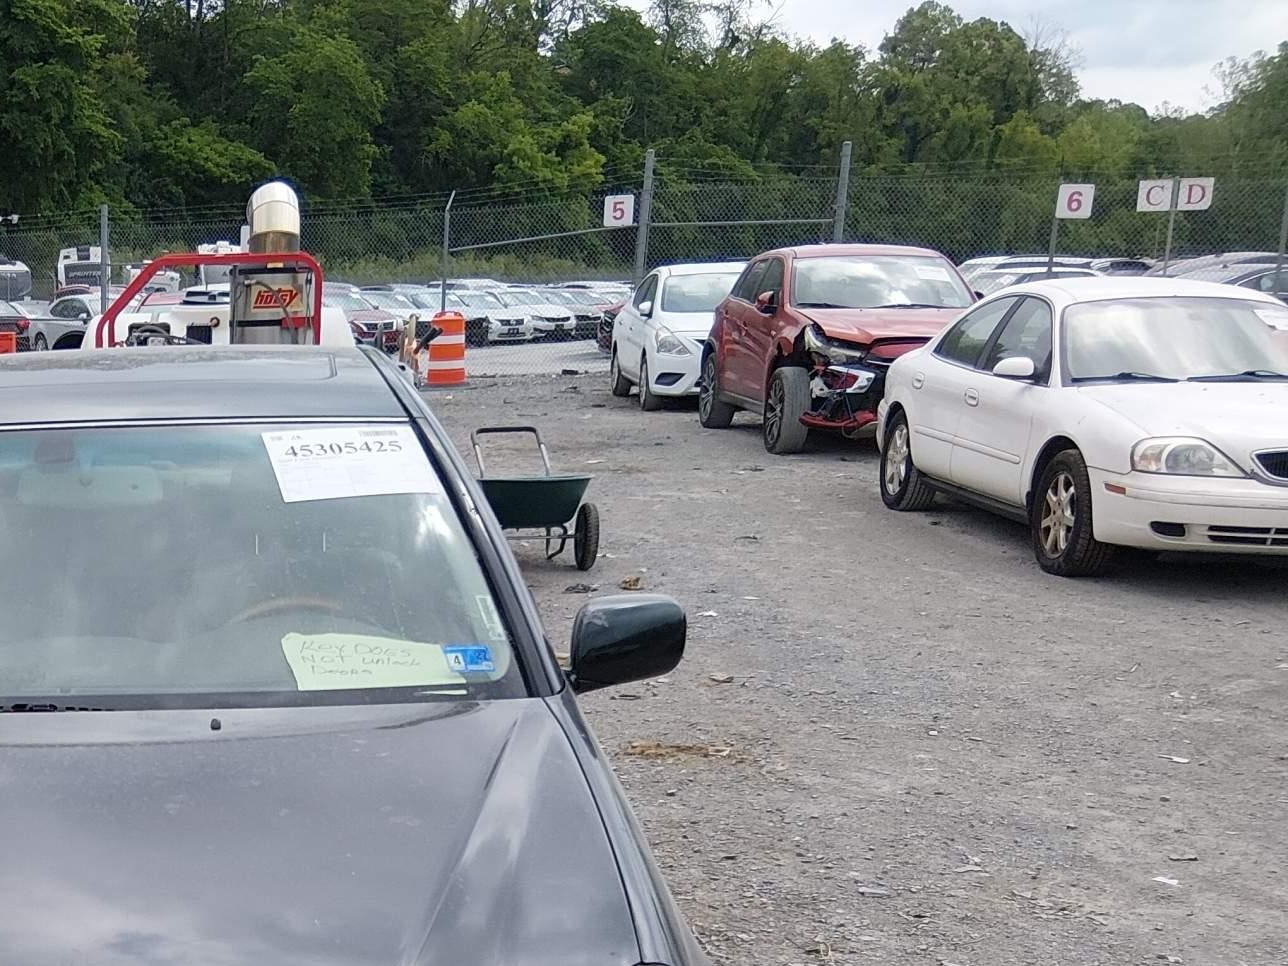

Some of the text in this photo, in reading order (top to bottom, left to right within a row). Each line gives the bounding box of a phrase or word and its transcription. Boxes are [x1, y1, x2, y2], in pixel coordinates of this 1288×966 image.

[1066, 190, 1084, 213] 6
[1145, 183, 1207, 206] C D
[612, 200, 626, 221] 5
[284, 440, 403, 458] 45305425
